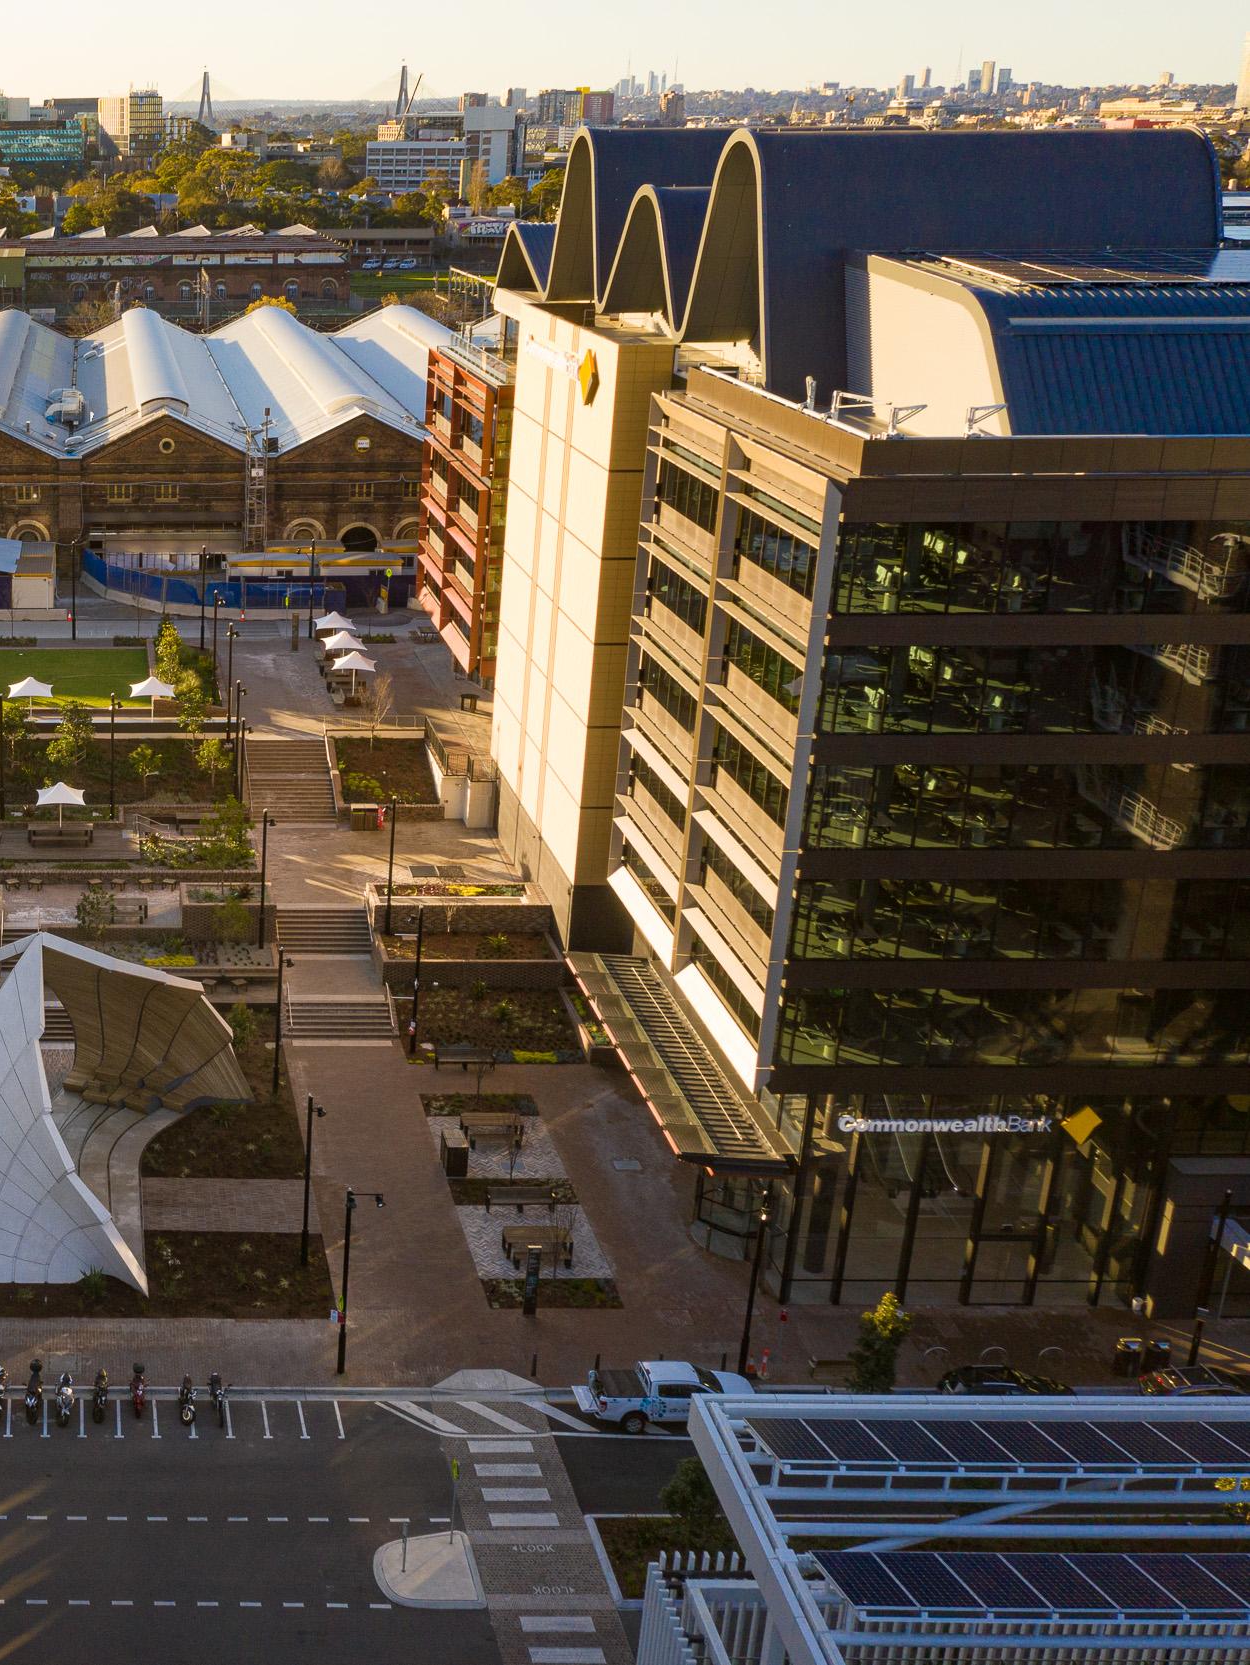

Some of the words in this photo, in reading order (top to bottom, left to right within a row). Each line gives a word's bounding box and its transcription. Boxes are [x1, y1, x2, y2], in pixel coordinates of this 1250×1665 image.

[838, 1114, 1052, 1132] CommonwealthBank
[519, 1544, 556, 1552] LOOK
[532, 1585, 569, 1595] LOOK
